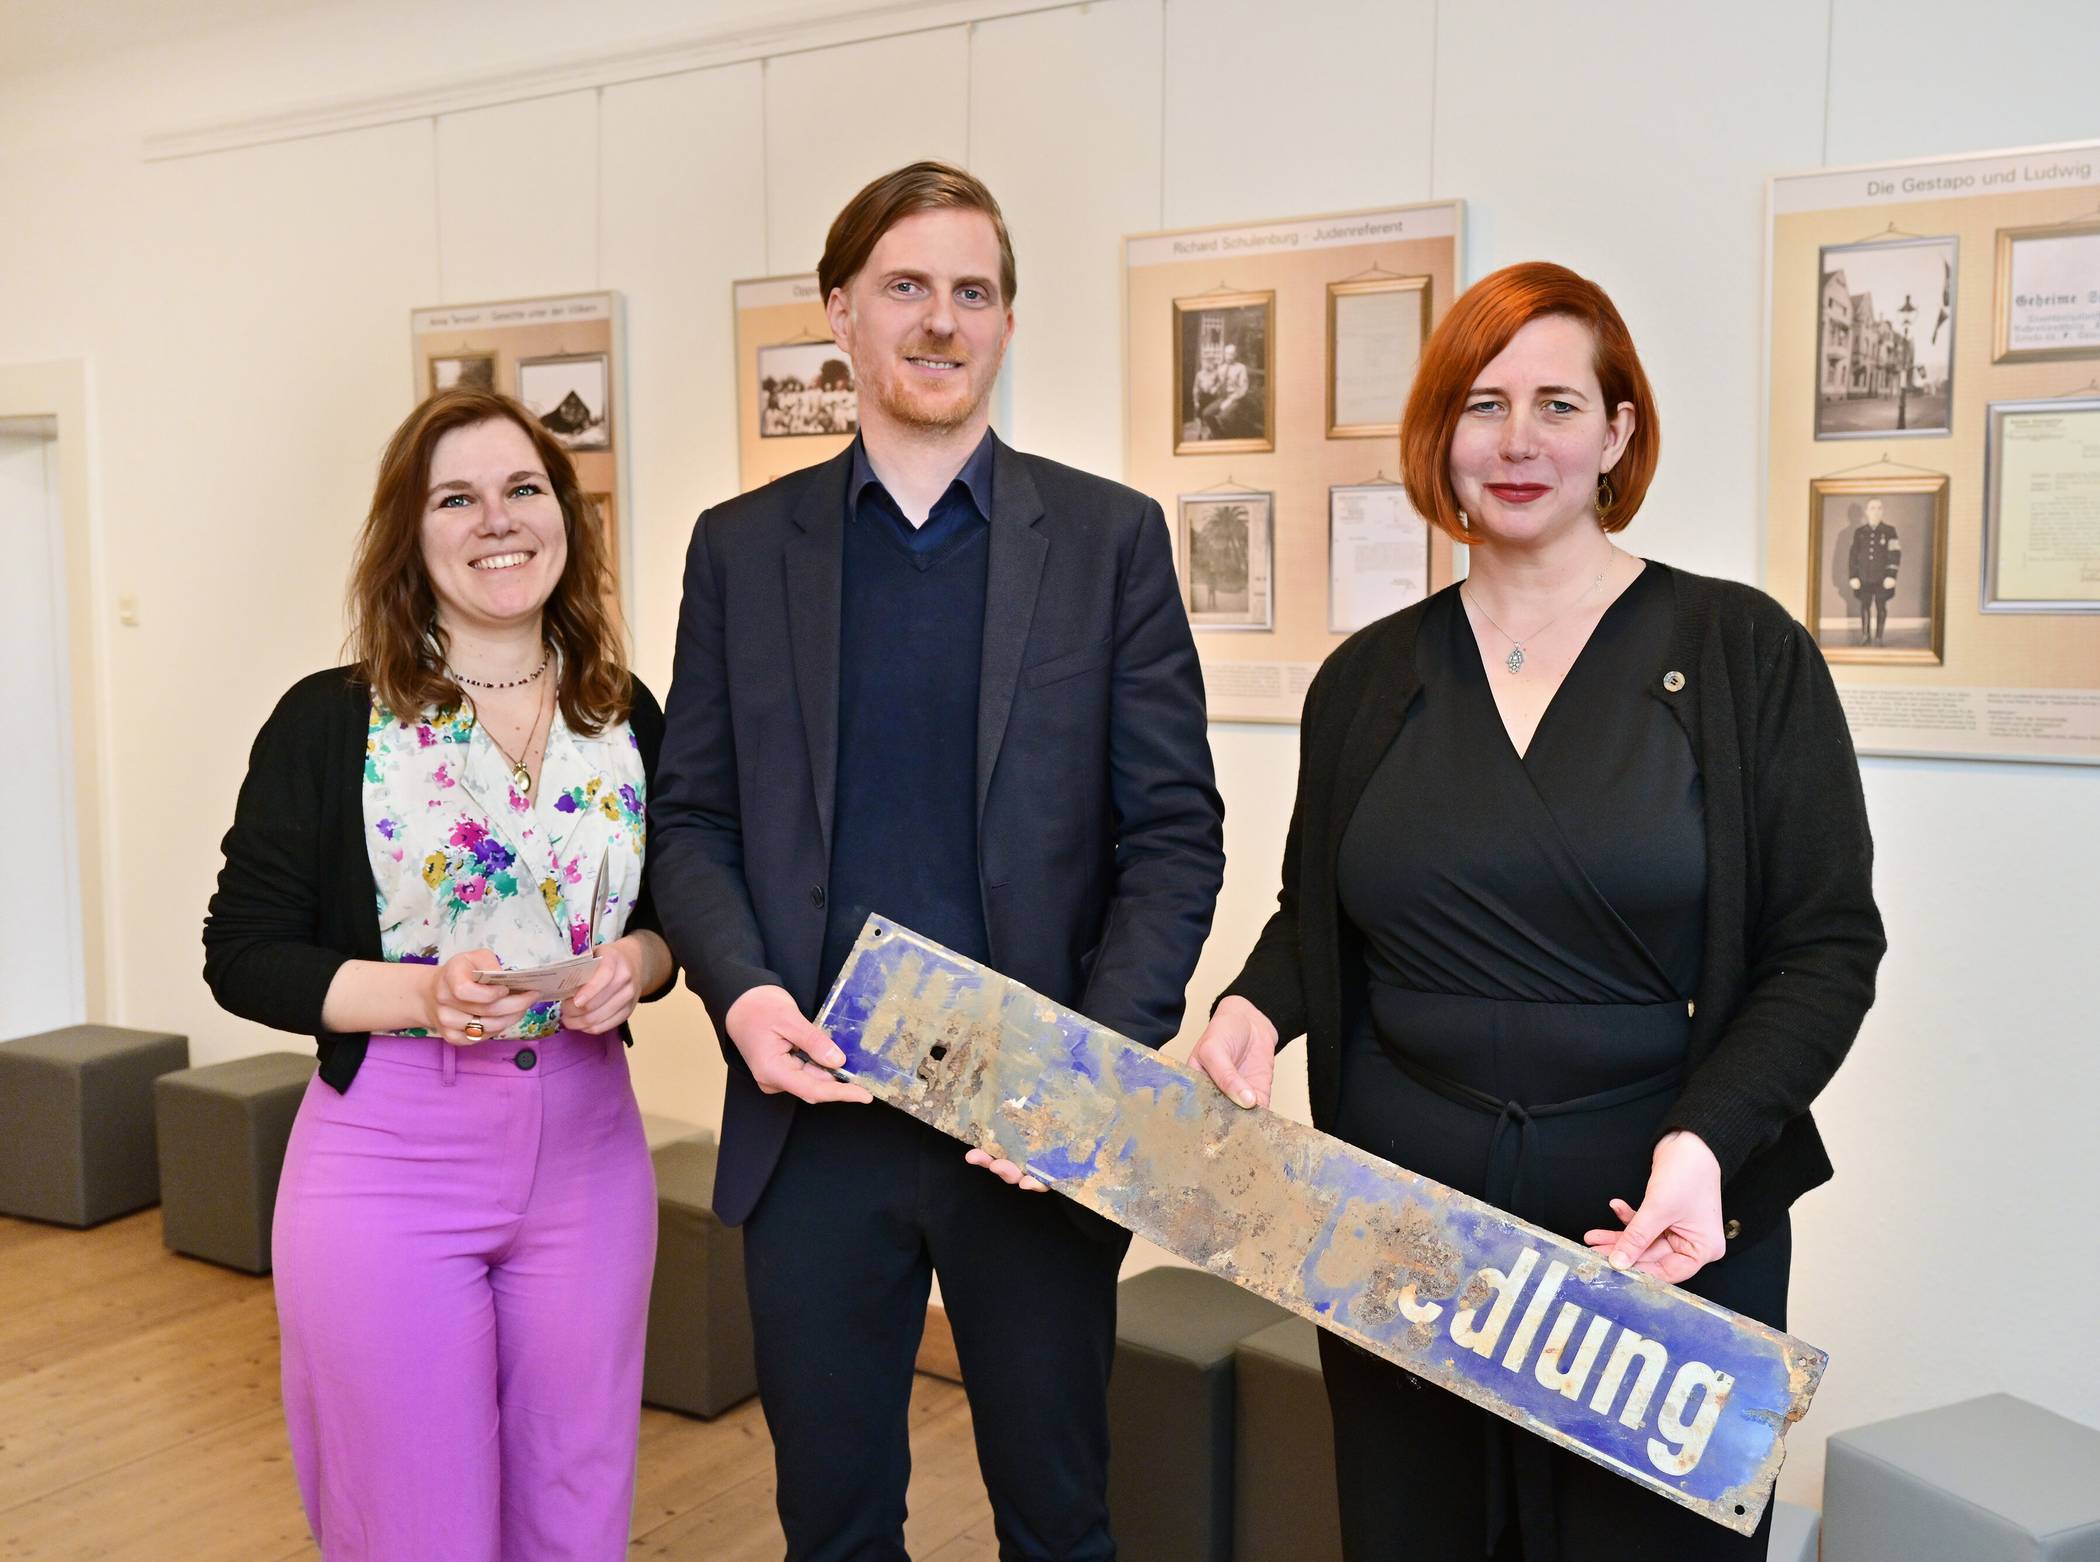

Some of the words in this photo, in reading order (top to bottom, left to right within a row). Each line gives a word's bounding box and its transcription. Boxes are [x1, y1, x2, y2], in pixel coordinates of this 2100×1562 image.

[1867, 180, 1894, 197] Die
[1901, 175, 1976, 194] Gestapo
[1982, 168, 2017, 186] und
[2024, 161, 2092, 182] Ludwig
[1172, 238, 1218, 255] Richard
[1222, 230, 1299, 251] Schulenburg
[1313, 221, 1404, 242] Judenreferent
[2015, 293, 2077, 307] Geheime
